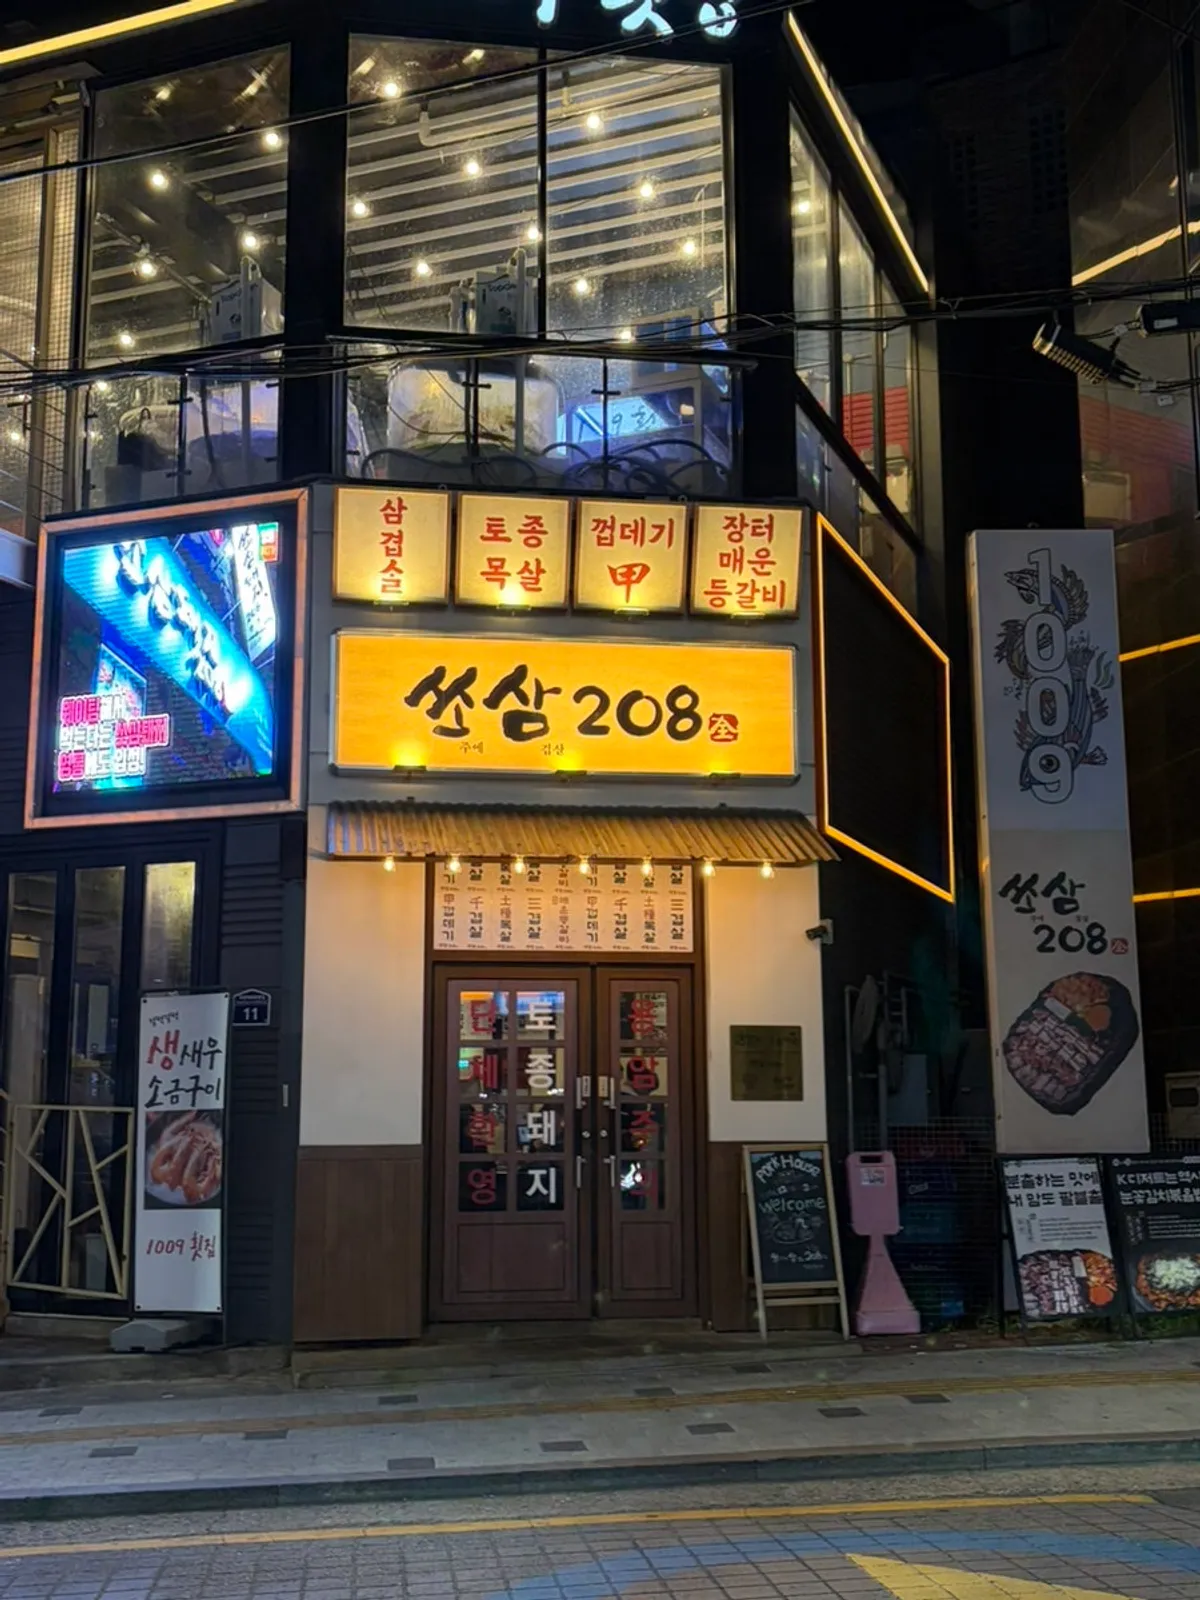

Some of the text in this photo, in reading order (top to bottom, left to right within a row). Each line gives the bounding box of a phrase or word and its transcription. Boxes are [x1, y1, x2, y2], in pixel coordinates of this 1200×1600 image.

[480, 515, 549, 549] 토종
[590, 514, 675, 548] 껍데기
[722, 512, 774, 544] 장터
[480, 557, 547, 592] 목살
[718, 545, 777, 576] 매운
[607, 563, 650, 603] 甲
[703, 578, 786, 609] 등갈비
[1034, 922, 1108, 955] 208
[242, 1007, 259, 1021] 11
[144, 1074, 221, 1108] 소금구이
[146, 1231, 216, 1262] 1009 횟집
